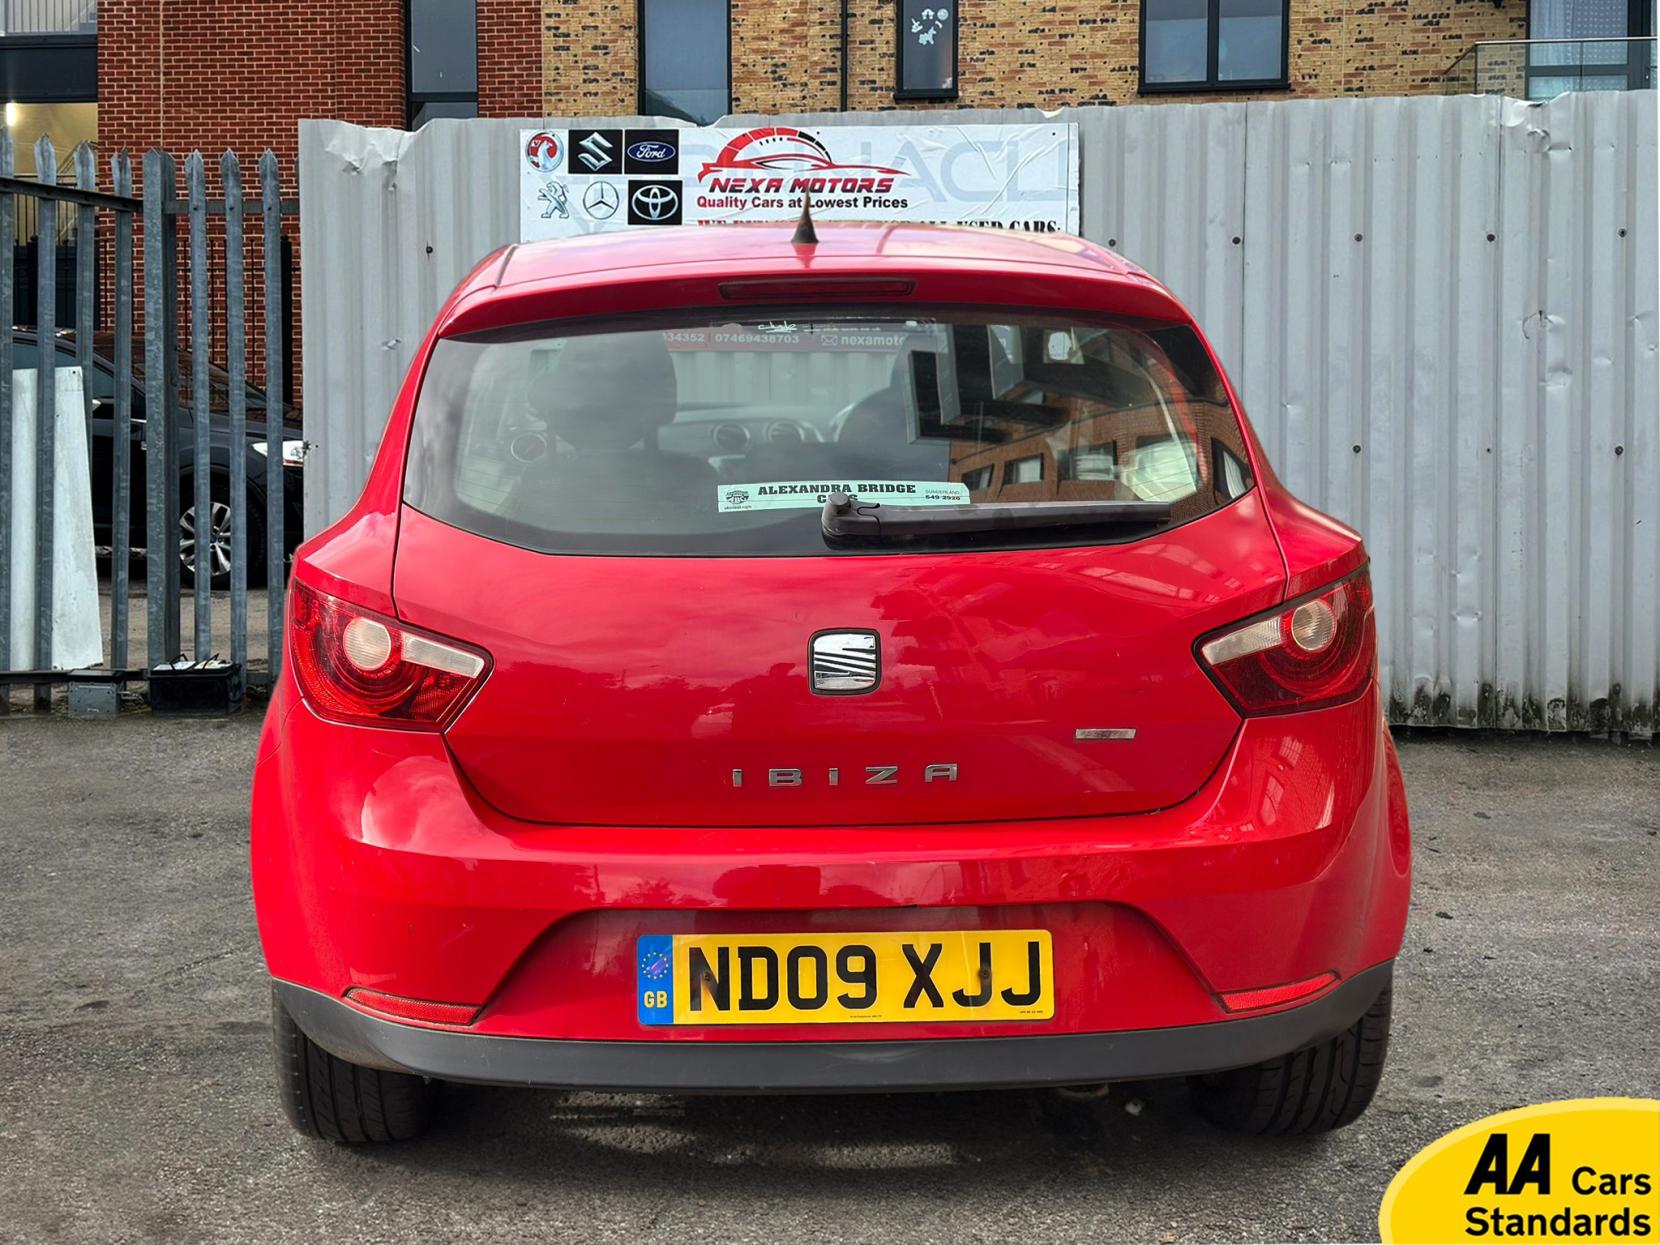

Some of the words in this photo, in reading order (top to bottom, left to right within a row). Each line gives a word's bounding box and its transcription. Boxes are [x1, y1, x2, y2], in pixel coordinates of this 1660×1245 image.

[636, 144, 667, 159] Ford
[708, 177, 784, 194] NEXA
[793, 177, 895, 194] MOTORS
[696, 196, 746, 211] Quality
[751, 196, 784, 209] Cars
[788, 197, 803, 209] at
[807, 196, 859, 209] Lowest
[863, 196, 909, 209] Prices
[758, 484, 852, 496] ALEXANDRA
[857, 483, 917, 495] BRIDGE
[817, 493, 859, 504] CS
[731, 763, 959, 788] IBIZA
[688, 944, 878, 1012] ND09
[901, 941, 1042, 1009] XJJ
[643, 990, 668, 1009] GB
